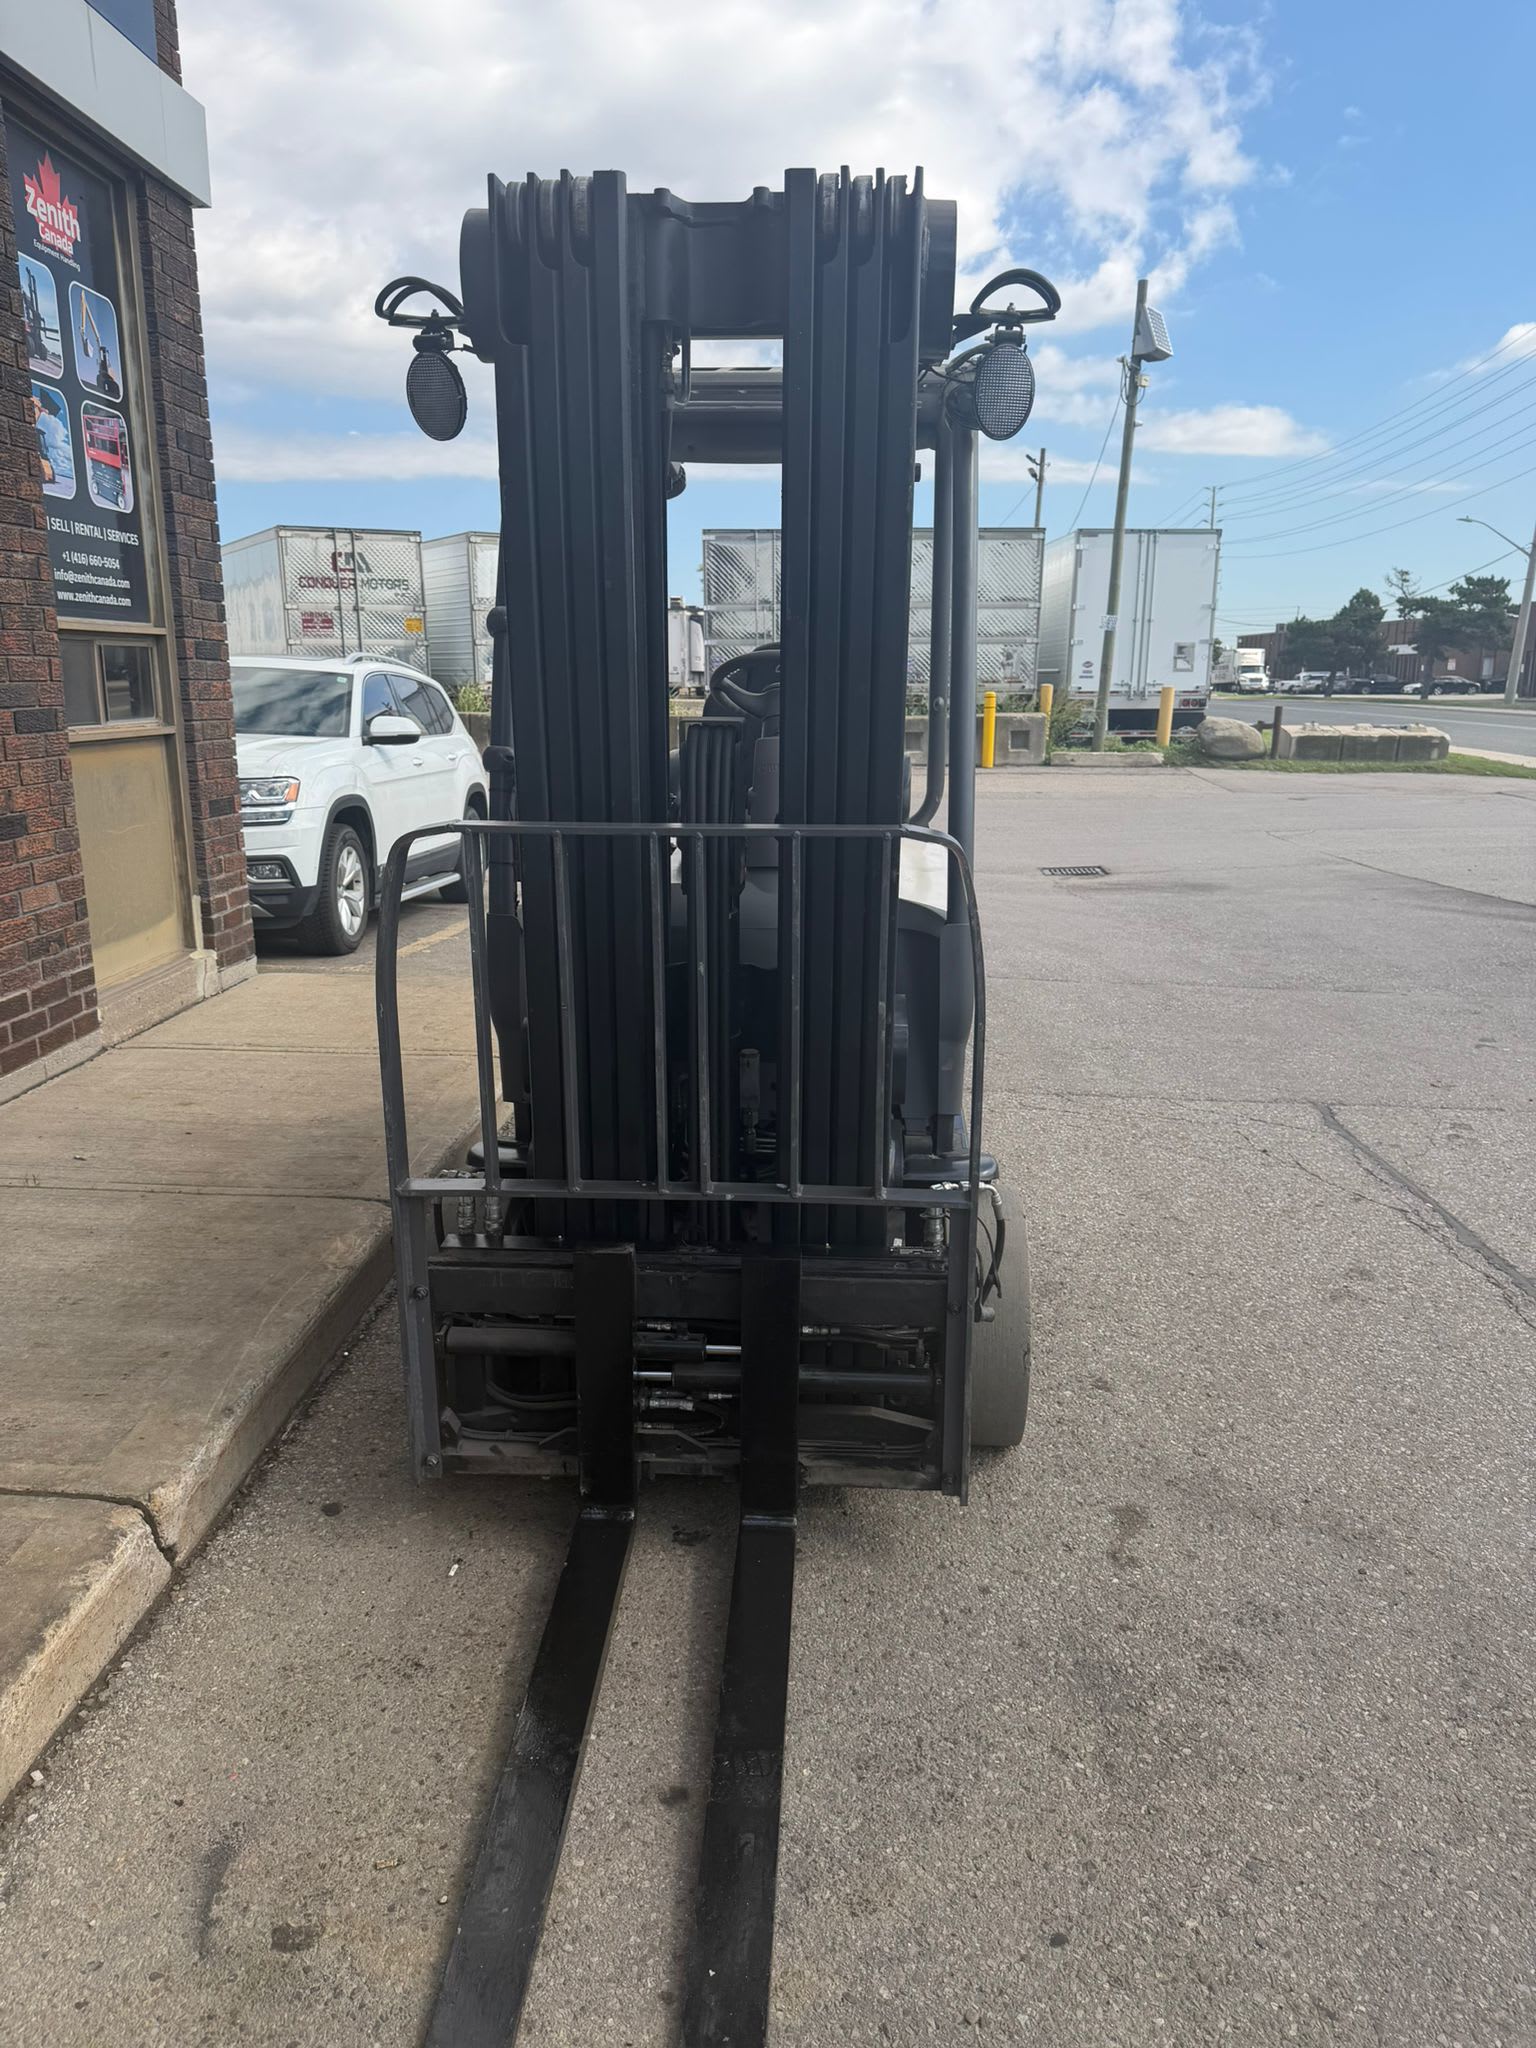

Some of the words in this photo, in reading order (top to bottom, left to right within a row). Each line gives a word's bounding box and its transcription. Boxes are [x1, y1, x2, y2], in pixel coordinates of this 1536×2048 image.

[25, 184, 81, 242] Zenith
[39, 221, 74, 255] Canada
[51, 517, 70, 532] SELL
[75, 522, 103, 539] RENTAL
[107, 529, 139, 546] SERVICES
[62, 550, 71, 563] +1
[71, 551, 88, 566] (416)
[54, 568, 130, 588] info@zenithcanada.com
[361, 578, 410, 591] MOTORS
[57, 590, 131, 606] www.zenithcanada.com
